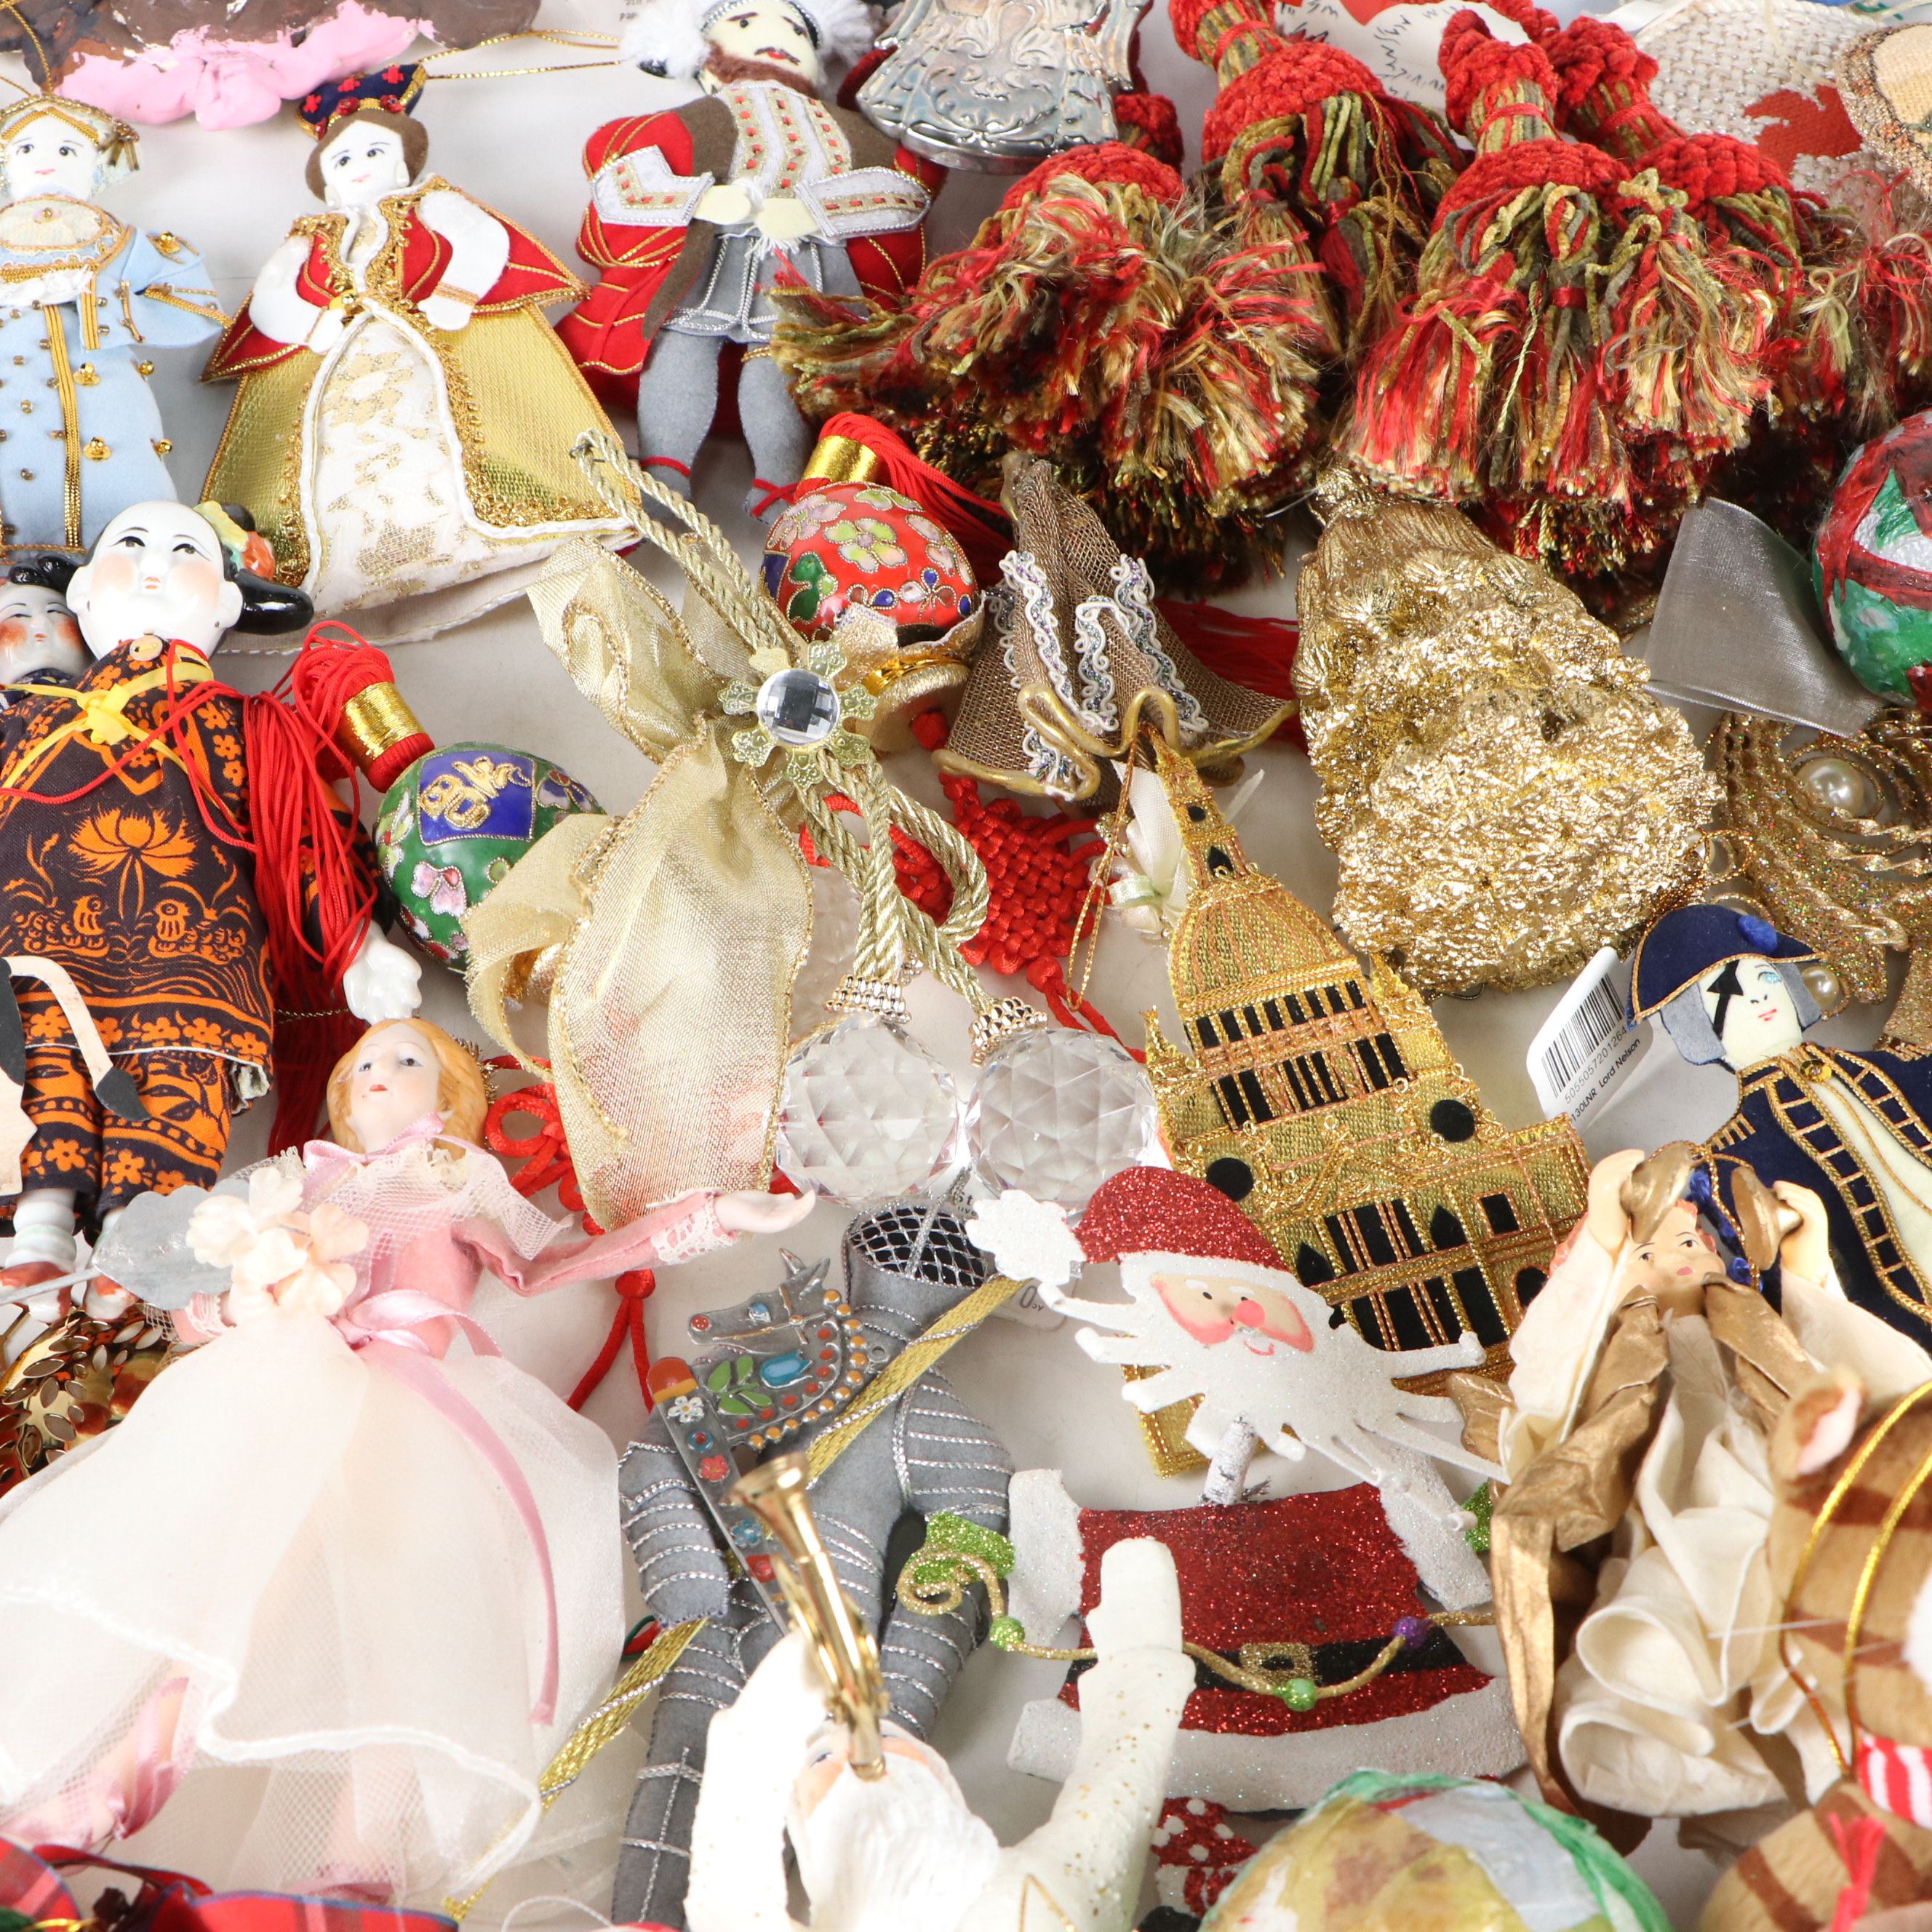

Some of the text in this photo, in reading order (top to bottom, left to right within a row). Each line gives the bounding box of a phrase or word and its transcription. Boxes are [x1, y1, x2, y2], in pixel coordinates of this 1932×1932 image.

[1565, 1026, 1627, 1103] 5055057201264
[1570, 1038, 1640, 1122] 130LNR Lord Nelson
